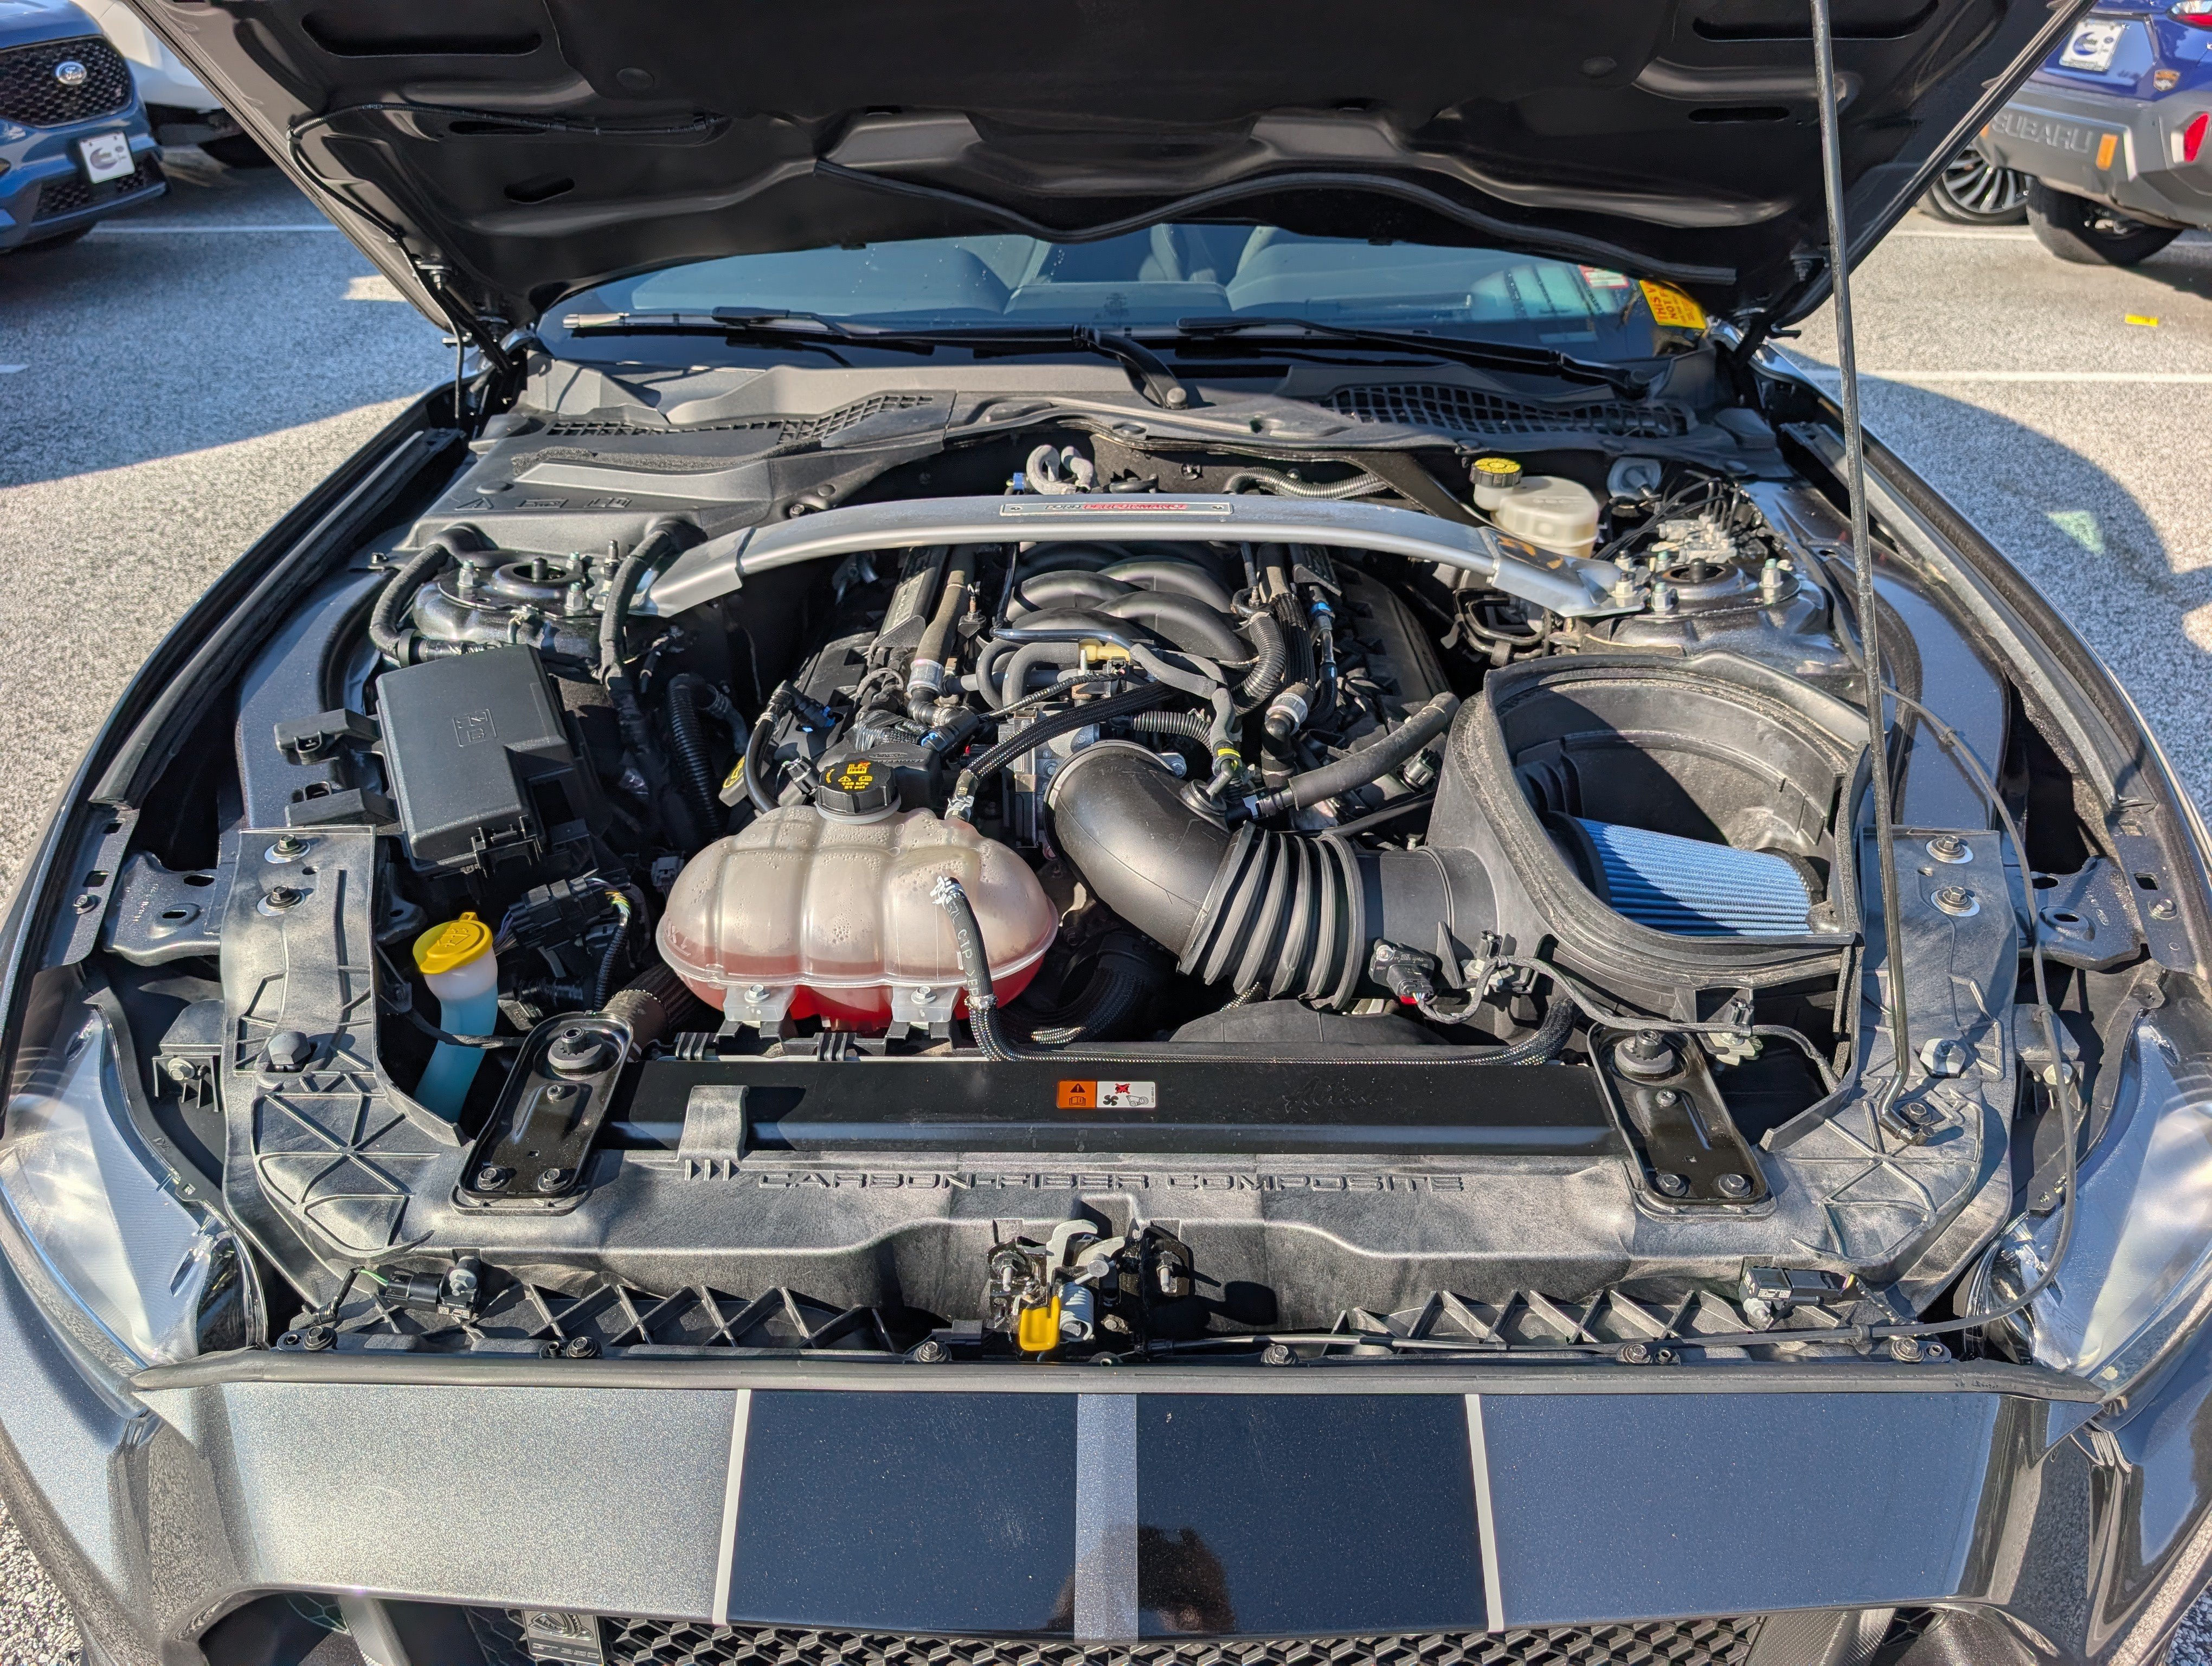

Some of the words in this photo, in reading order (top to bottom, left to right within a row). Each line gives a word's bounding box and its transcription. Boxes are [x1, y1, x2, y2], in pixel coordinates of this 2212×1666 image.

[1991, 113, 2093, 153] SUBARU
[1650, 297, 1668, 321] THIS
[1663, 300, 1678, 319] NOT
[759, 1172, 1148, 1189] CARBON-FIBER
[1167, 1174, 1463, 1192] COMPOSITE
